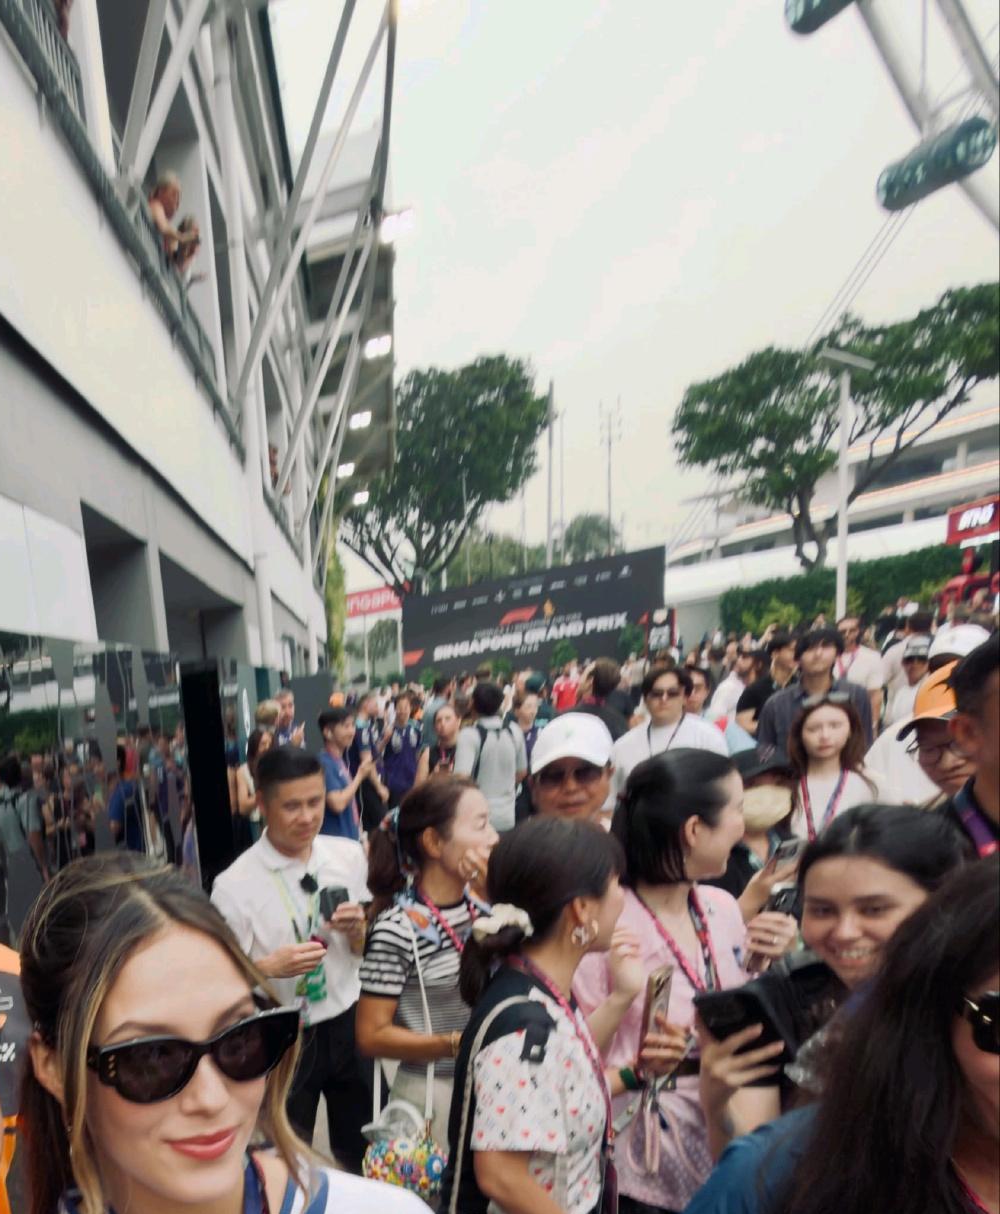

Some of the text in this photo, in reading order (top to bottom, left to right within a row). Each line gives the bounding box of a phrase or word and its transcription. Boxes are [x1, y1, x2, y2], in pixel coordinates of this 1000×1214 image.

[433, 630, 523, 662] SINGAPORE
[524, 619, 585, 644] GRAND
[585, 611, 628, 635] PRIX
